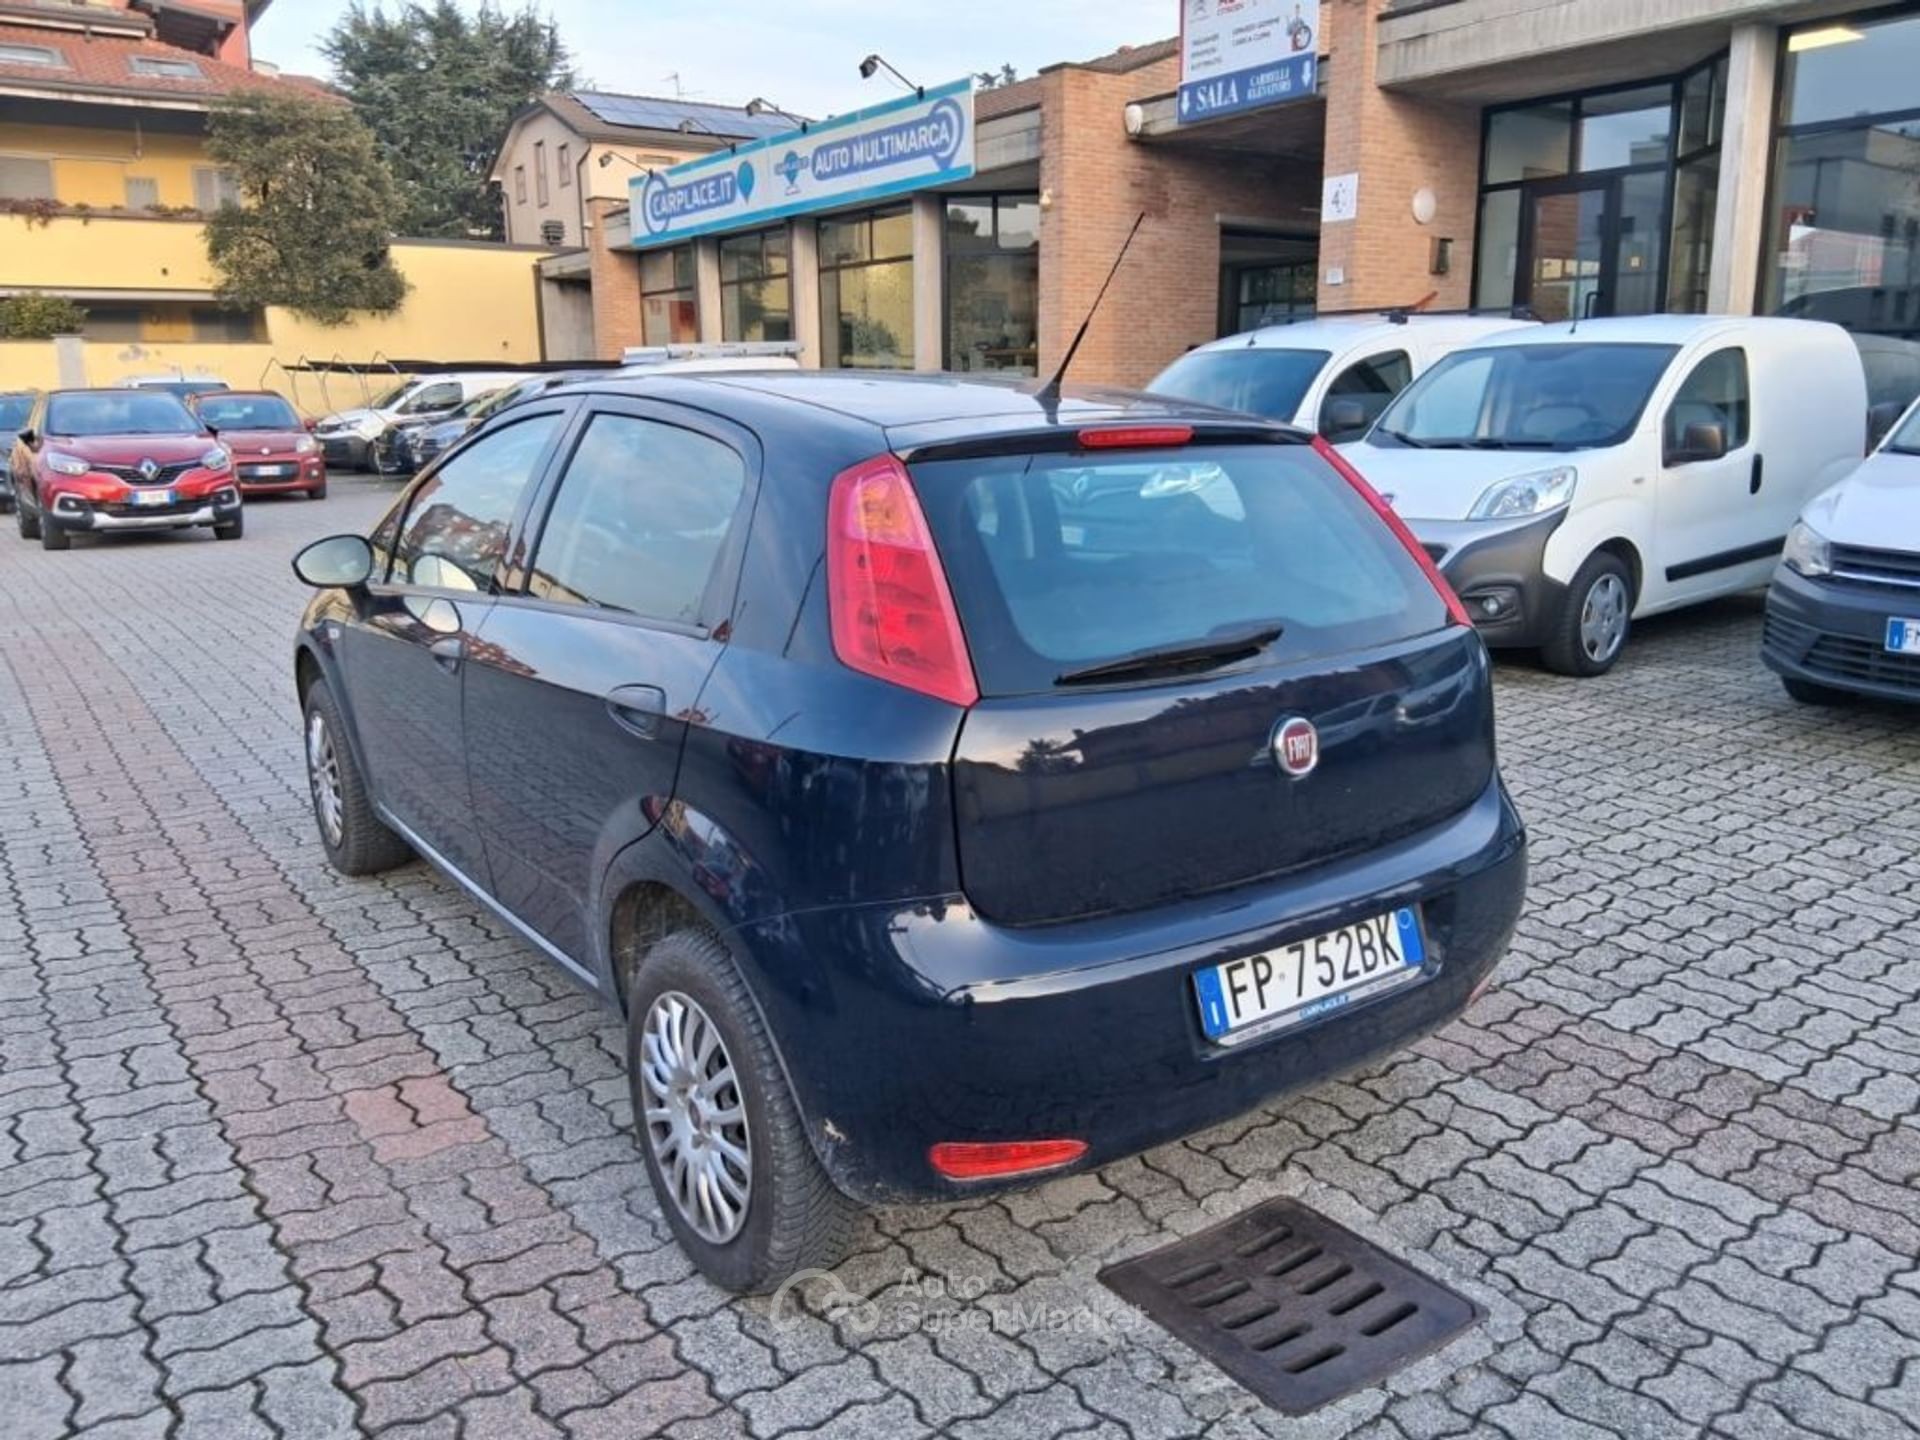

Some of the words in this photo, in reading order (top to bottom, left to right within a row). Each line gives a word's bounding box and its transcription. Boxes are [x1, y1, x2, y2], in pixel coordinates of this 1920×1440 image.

[1196, 78, 1239, 112] SALA
[814, 145, 849, 174] AUTO
[852, 119, 951, 165] MULTIMARCA
[652, 174, 733, 217] CARPLACE.IT
[1287, 732, 1311, 762] FIAT
[1225, 955, 1273, 1019] FP
[1287, 911, 1401, 998] 752BK
